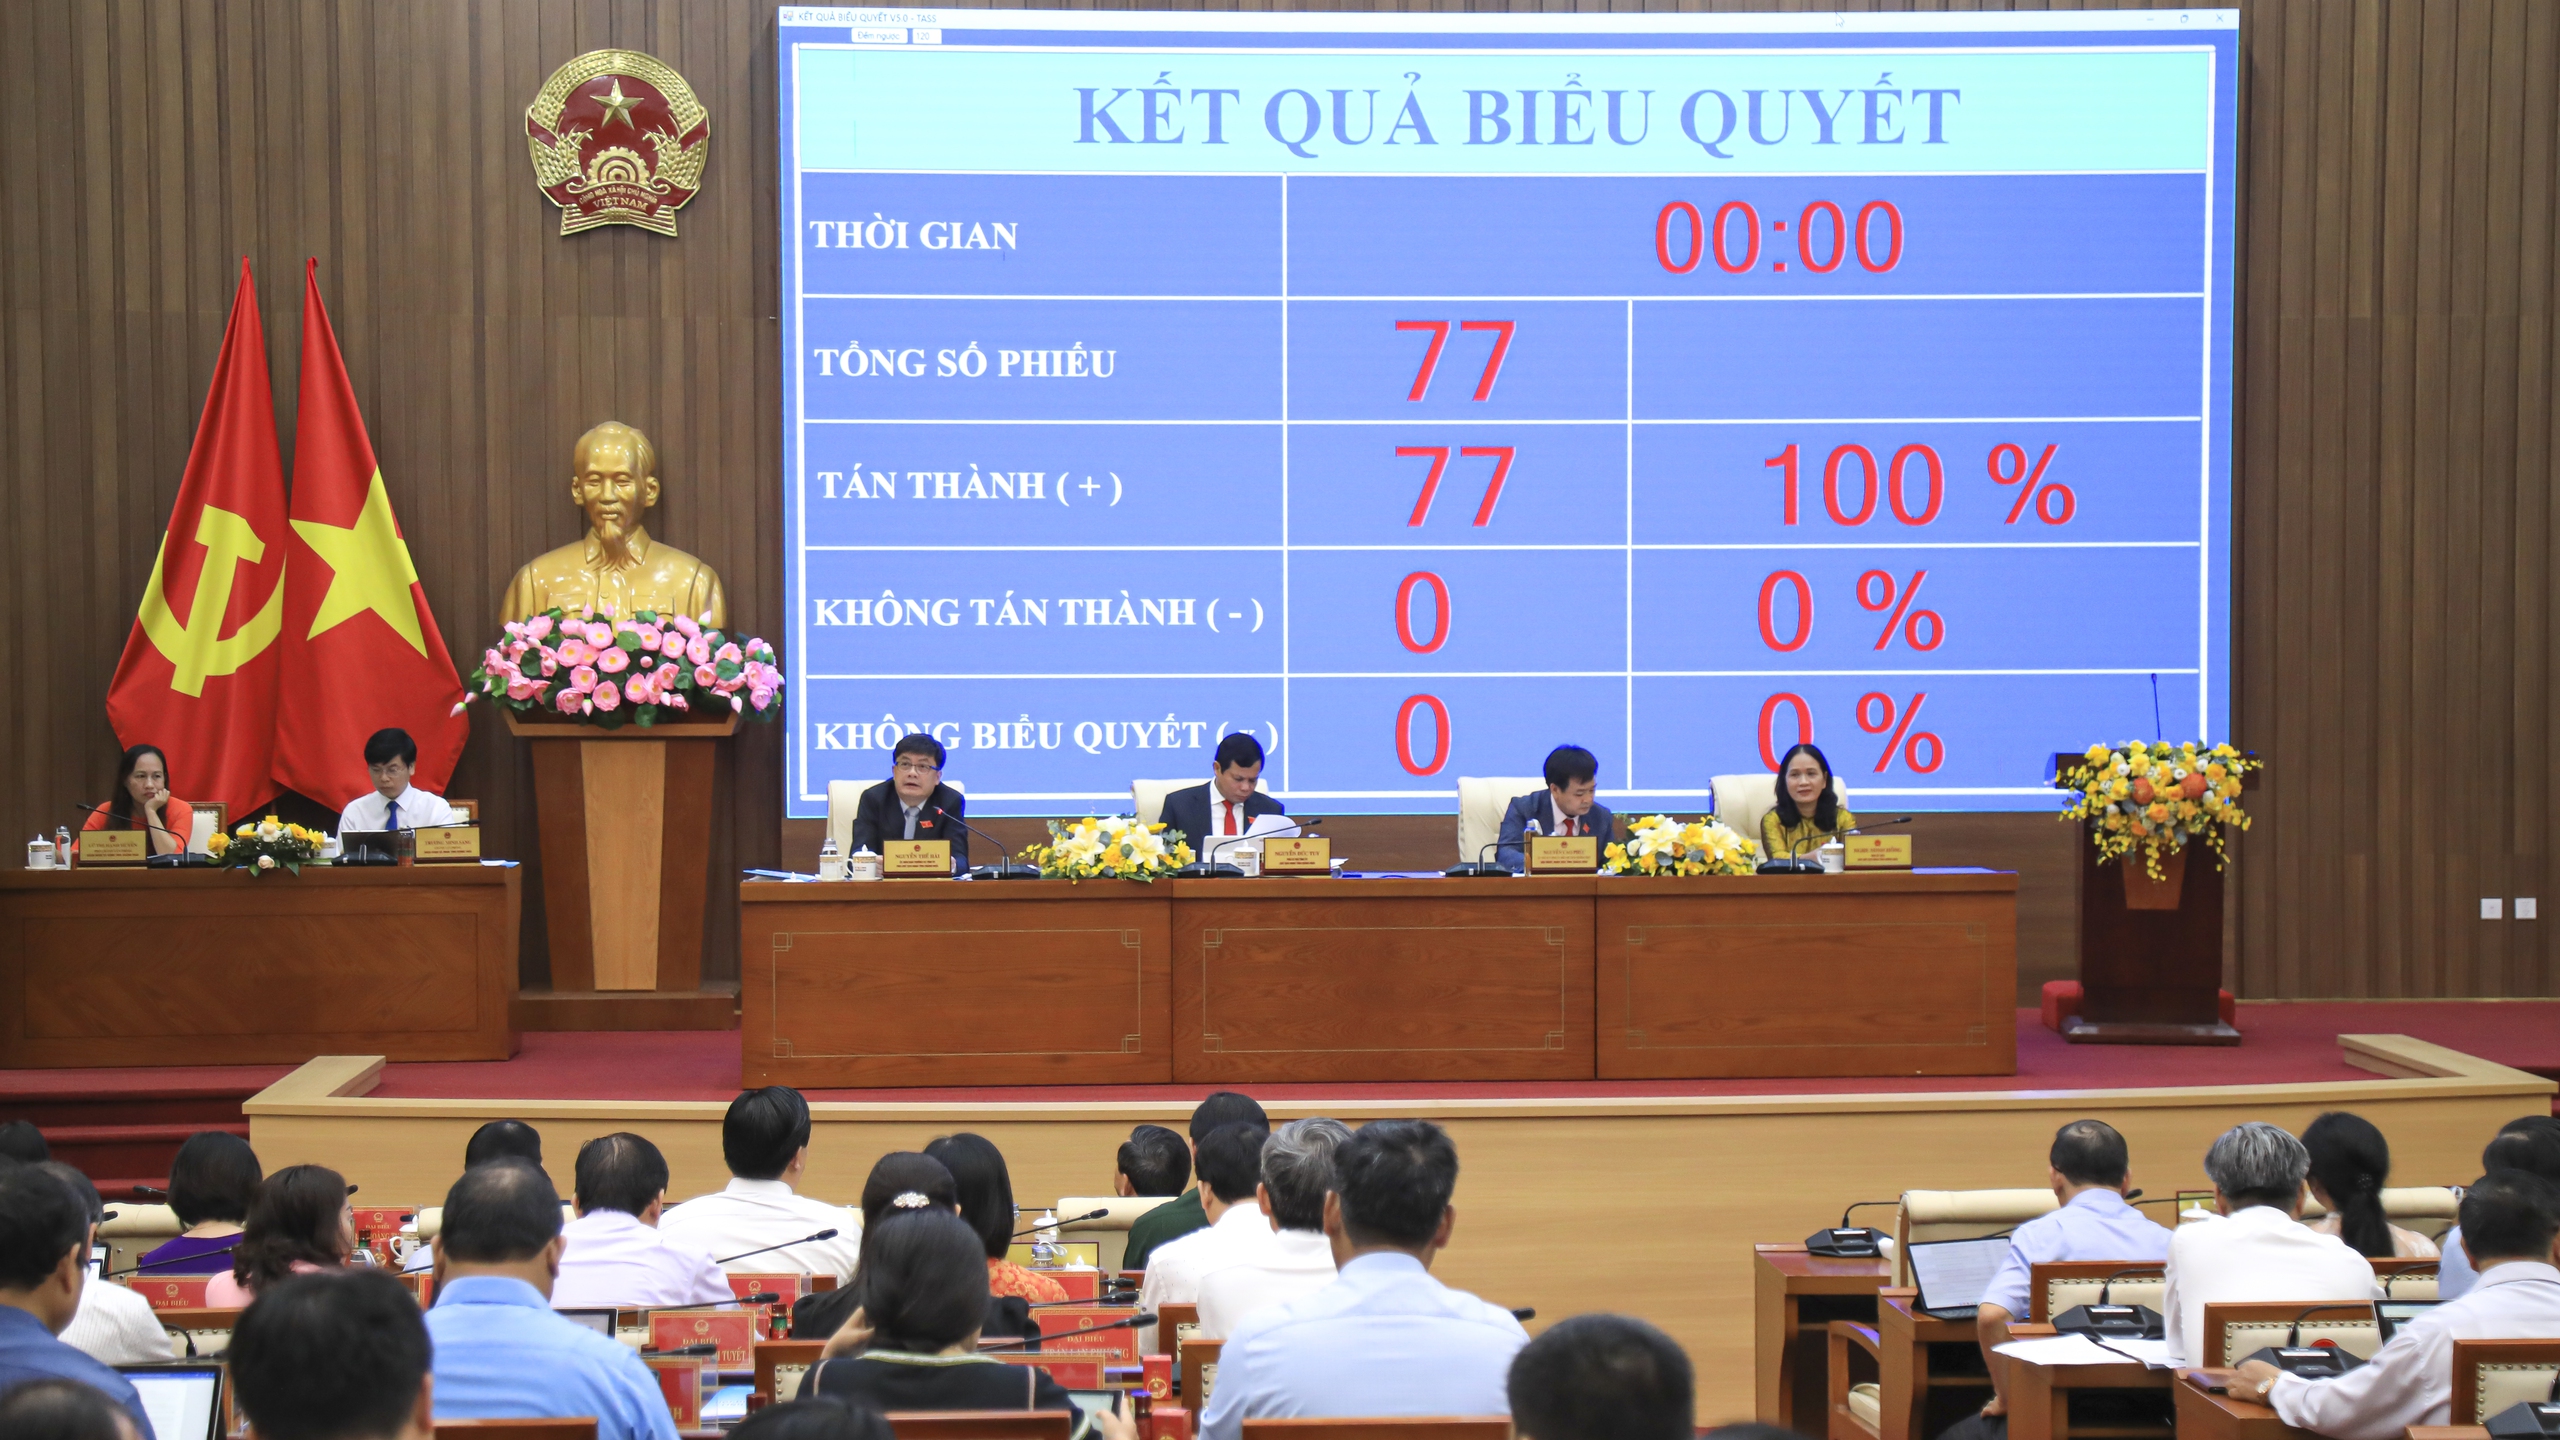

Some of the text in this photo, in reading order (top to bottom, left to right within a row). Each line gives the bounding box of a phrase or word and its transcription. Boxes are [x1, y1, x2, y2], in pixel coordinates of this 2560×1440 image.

[798, 11, 813, 22] KẾT
[816, 11, 836, 23] QUẢ
[860, 12, 888, 23] QUYẾT
[917, 14, 937, 23] TASS
[916, 31, 931, 41] 120
[1073, 71, 1961, 160] KẾT QUẢ BIỂU QUYẾT
[593, 195, 649, 211] VIỆT NAM
[809, 212, 1019, 251] THỜI GIAN
[1655, 199, 1904, 275] 00:00
[813, 340, 1118, 379] TỔNG SỐ PHIẾU
[1395, 320, 1516, 401] 77
[817, 462, 897, 500] TÁN
[907, 463, 1047, 500] THÀNH
[1395, 446, 1516, 527] 77
[1763, 442, 2077, 527] 100 %
[813, 589, 961, 627] KHÔNG
[969, 590, 1050, 627] TÁN
[1058, 589, 1198, 627] THÀNH
[1394, 571, 1451, 654] 0
[1757, 568, 1945, 653] 0 %
[972, 713, 1064, 751] BIỂU
[1073, 713, 1208, 755] QUYẾT
[1394, 693, 1451, 777] 0
[1757, 691, 1945, 775] 0 %
[170, 1297, 189, 1307] BIỂU
[700, 1334, 721, 1345] BIỂU
[1067, 1333, 1106, 1344] ĐẠI BIỂU
